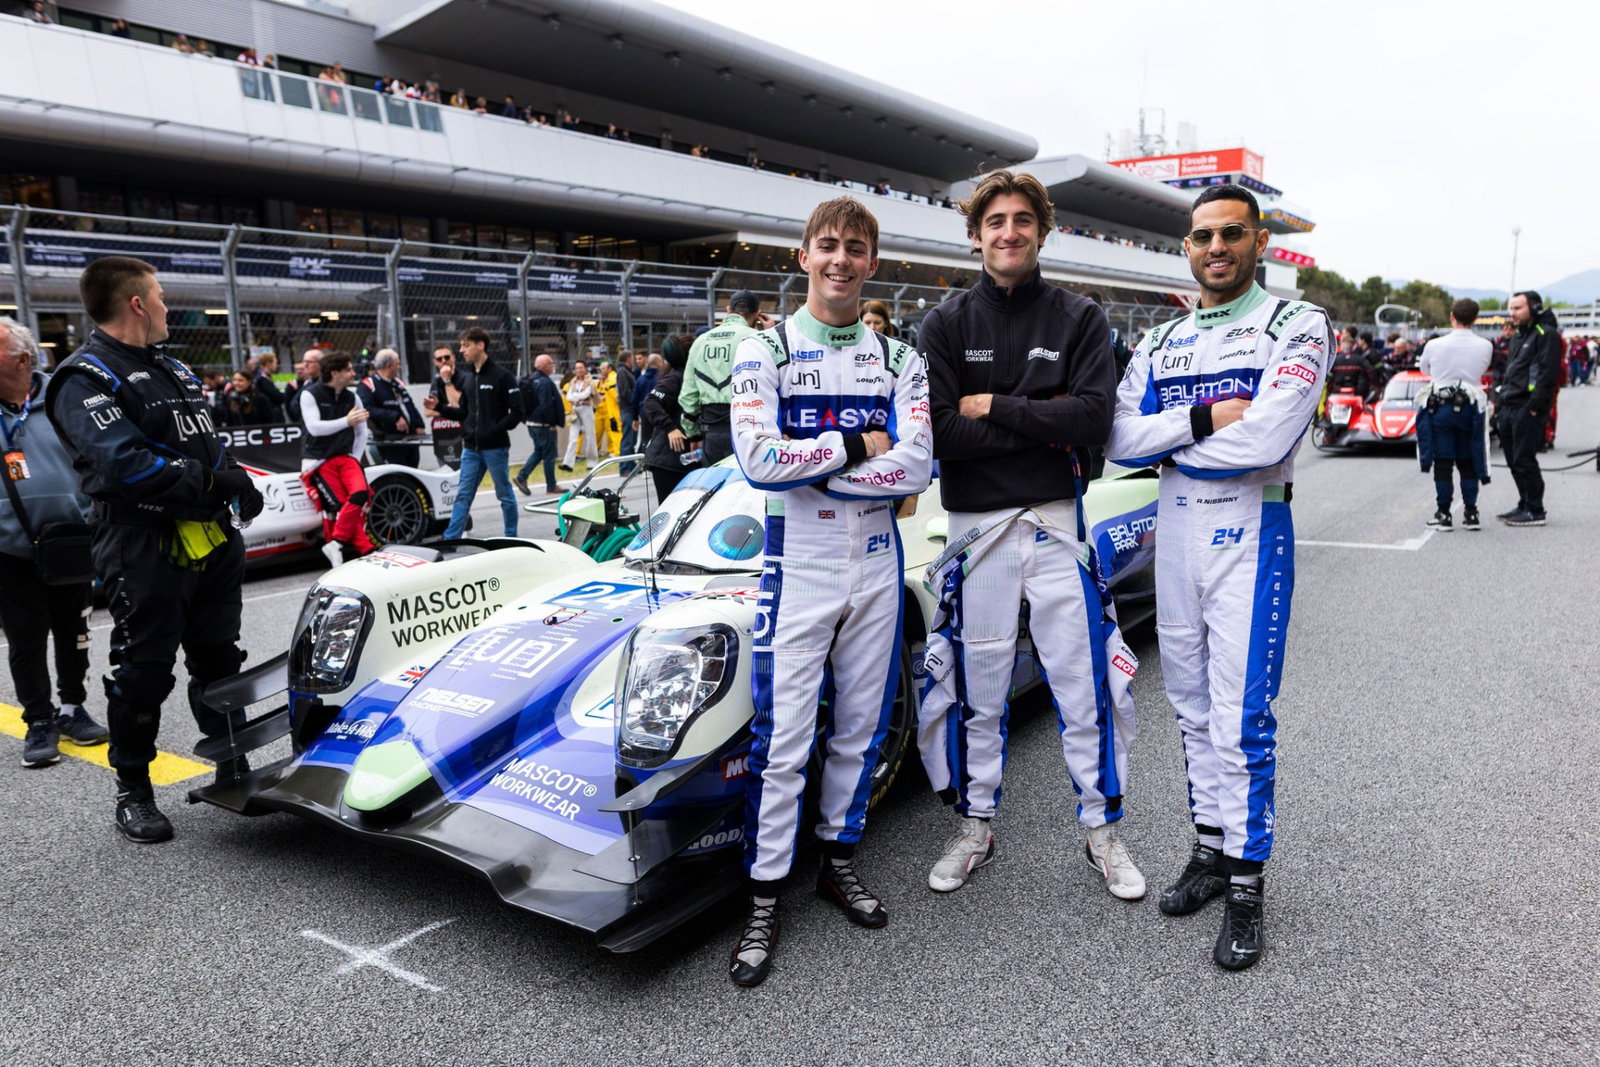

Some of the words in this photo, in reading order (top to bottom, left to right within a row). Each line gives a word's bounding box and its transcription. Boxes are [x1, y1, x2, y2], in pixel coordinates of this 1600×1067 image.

[1200, 308, 1232, 321] HRX
[1275, 303, 1306, 328] HRX
[829, 331, 858, 342] HRX
[893, 343, 909, 365] HRX
[1028, 347, 1060, 361] NIELSEN
[1160, 377, 1254, 402] BALATON
[433, 420, 461, 430] MOTUL
[867, 532, 890, 553] 24
[1114, 534, 1139, 554] PARK
[1210, 527, 1245, 546] 24
[1112, 656, 1137, 677] MOT
[415, 687, 496, 714] NIELSEN
[489, 772, 581, 821] WORKWEAR
